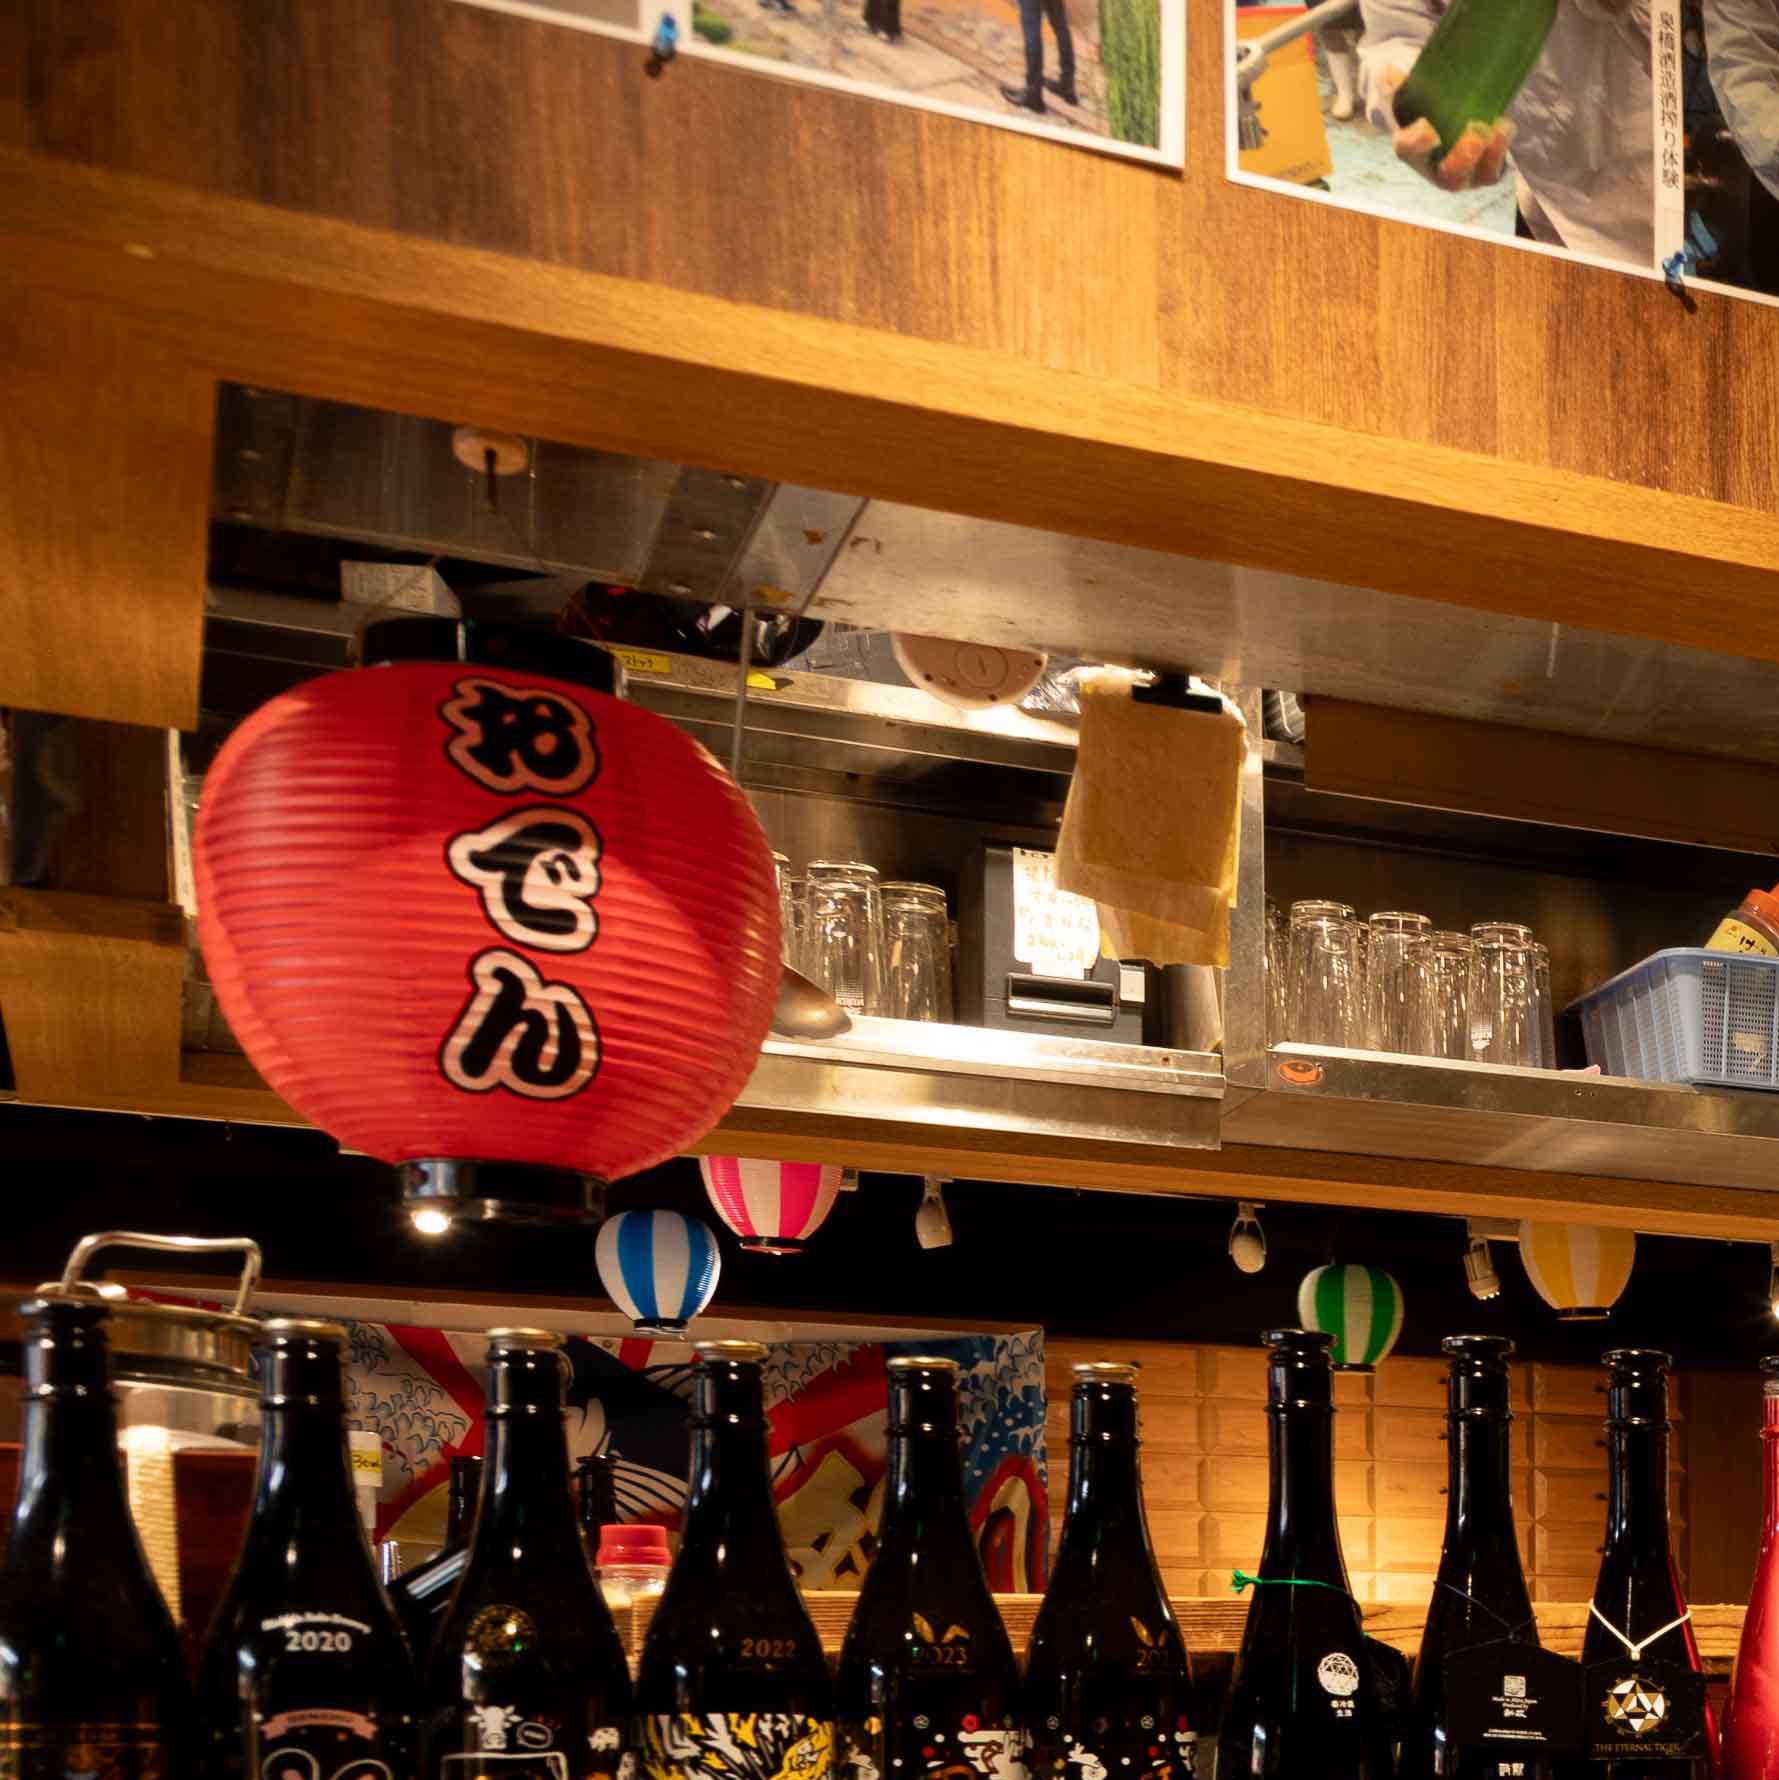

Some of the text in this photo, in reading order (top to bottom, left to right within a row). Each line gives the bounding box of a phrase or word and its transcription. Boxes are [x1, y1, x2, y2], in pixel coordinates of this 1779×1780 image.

[446, 680, 600, 1097] おでん
[285, 1630, 352, 1653] 2020
[740, 1639, 797, 1658] 2022
